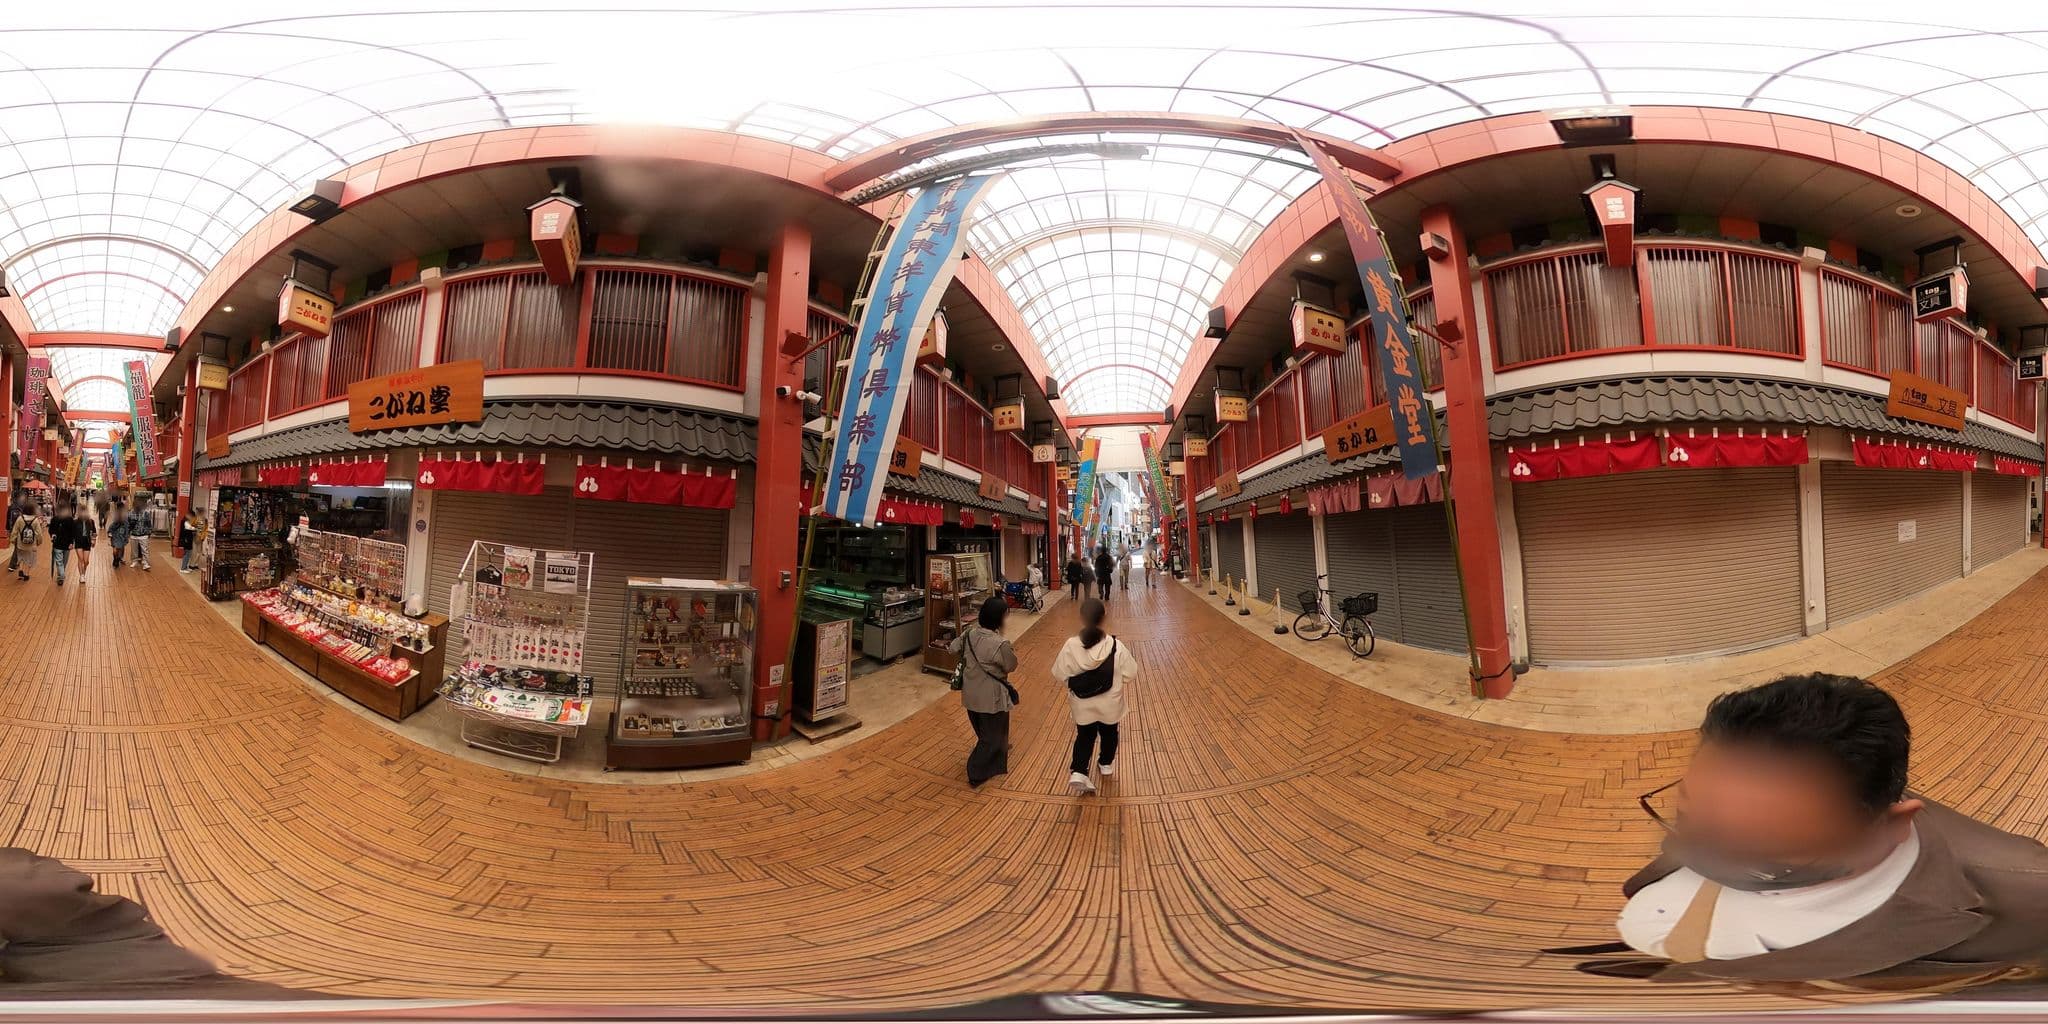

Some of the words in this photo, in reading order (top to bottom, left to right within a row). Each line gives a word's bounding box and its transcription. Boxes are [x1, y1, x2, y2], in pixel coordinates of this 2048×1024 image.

[1924, 286, 1940, 295] tag
[1919, 296, 1941, 312] 文具
[1310, 326, 1341, 343] あかね
[1366, 267, 1428, 447] 黄金堂
[369, 384, 451, 420] こがね堂
[1911, 388, 1928, 404] tag
[1937, 397, 1959, 418] 文具
[1337, 426, 1379, 454] あかね
[549, 565, 575, 575] TOKYO
